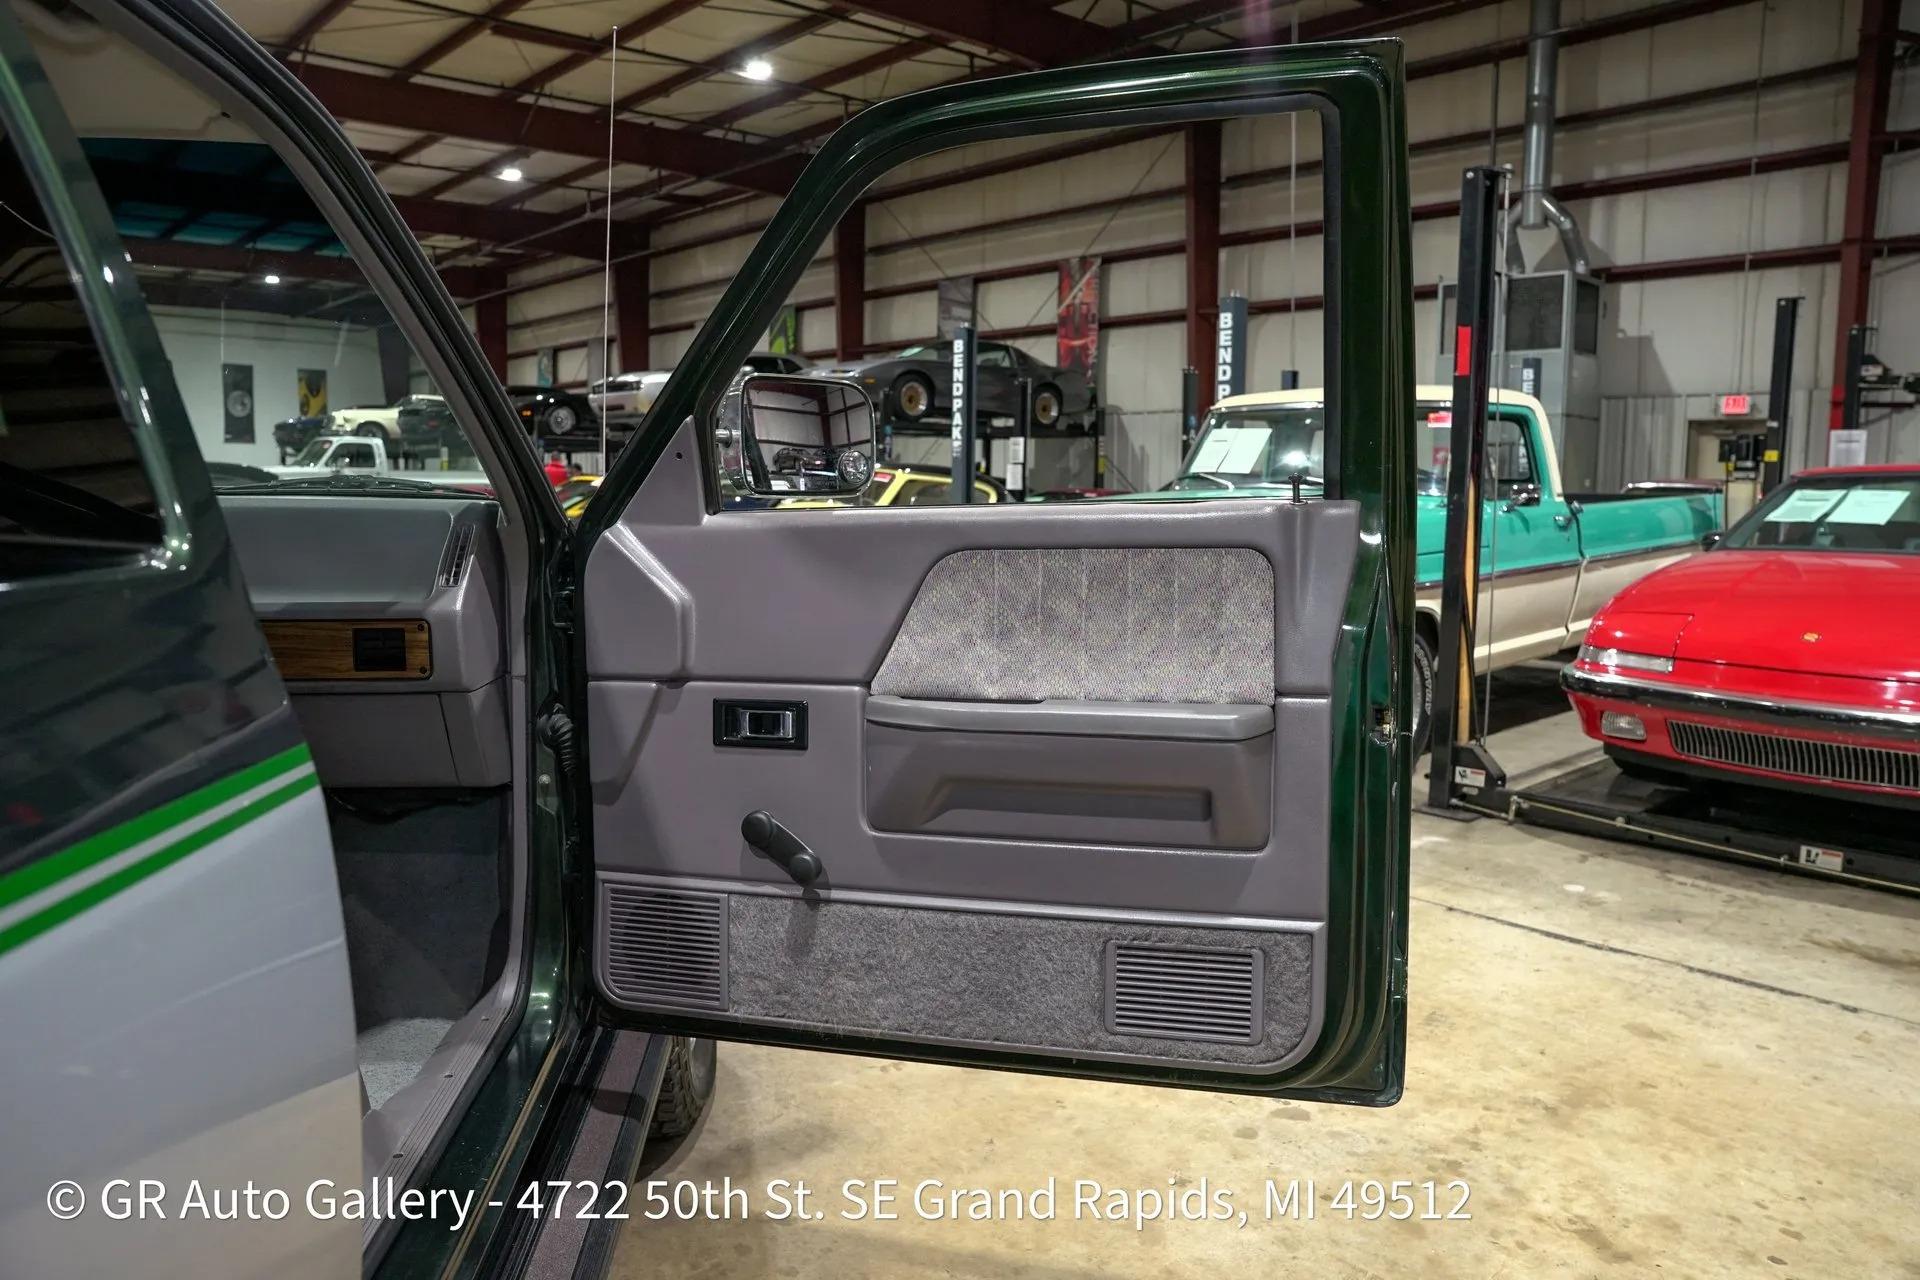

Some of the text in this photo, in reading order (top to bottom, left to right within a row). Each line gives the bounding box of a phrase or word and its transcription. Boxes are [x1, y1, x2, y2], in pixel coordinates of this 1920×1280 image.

[952, 339, 963, 440] BENDPAK
[1218, 312, 1232, 400] BENDP
[1725, 397, 1746, 409] EXIT
